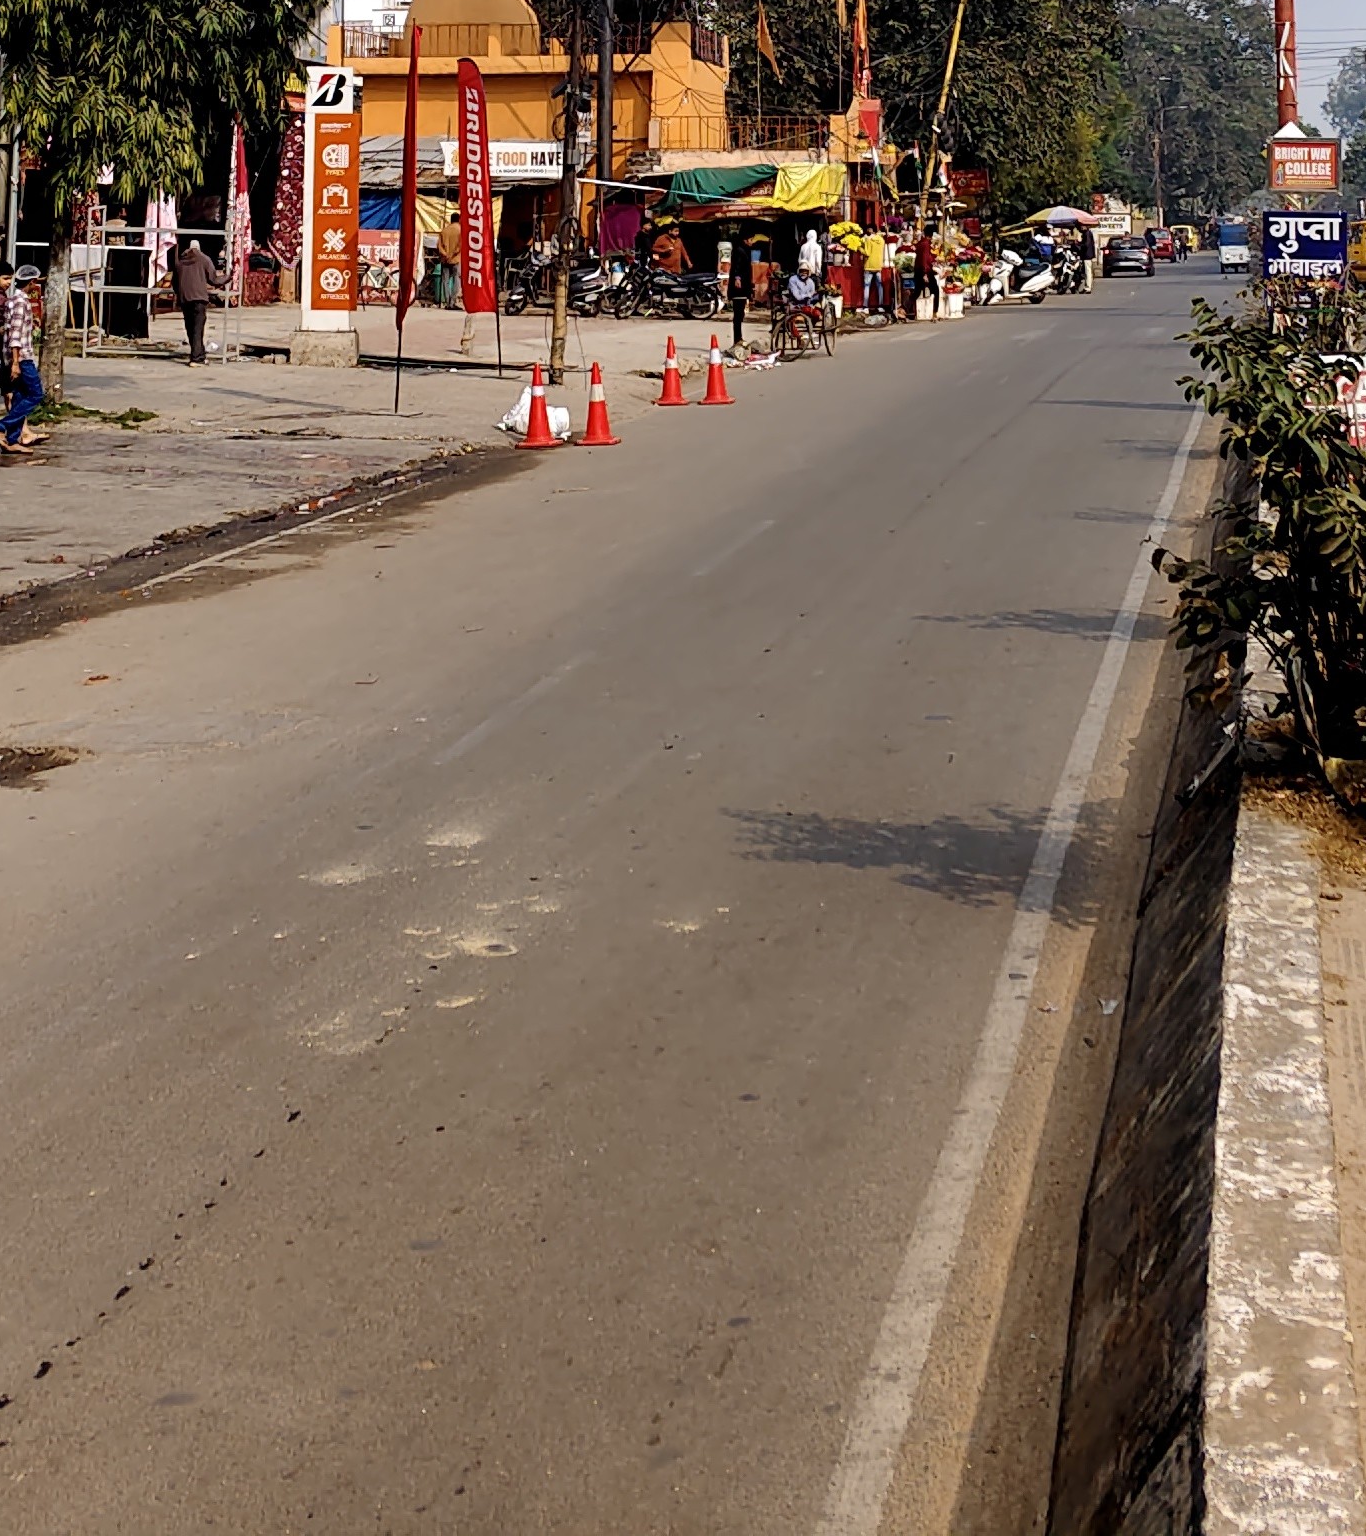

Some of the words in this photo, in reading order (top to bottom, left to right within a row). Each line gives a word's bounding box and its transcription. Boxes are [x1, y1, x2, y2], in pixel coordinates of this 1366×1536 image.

[496, 151, 527, 166] FOOD
[1274, 146, 1309, 161] BRIGHT
[1310, 146, 1332, 161] WAY
[1285, 162, 1332, 176] COLLEGE
[465, 86, 483, 288] BRIDGESTONE
[1269, 217, 1343, 253] गुप्ता
[1268, 253, 1344, 280] मोबाइल
